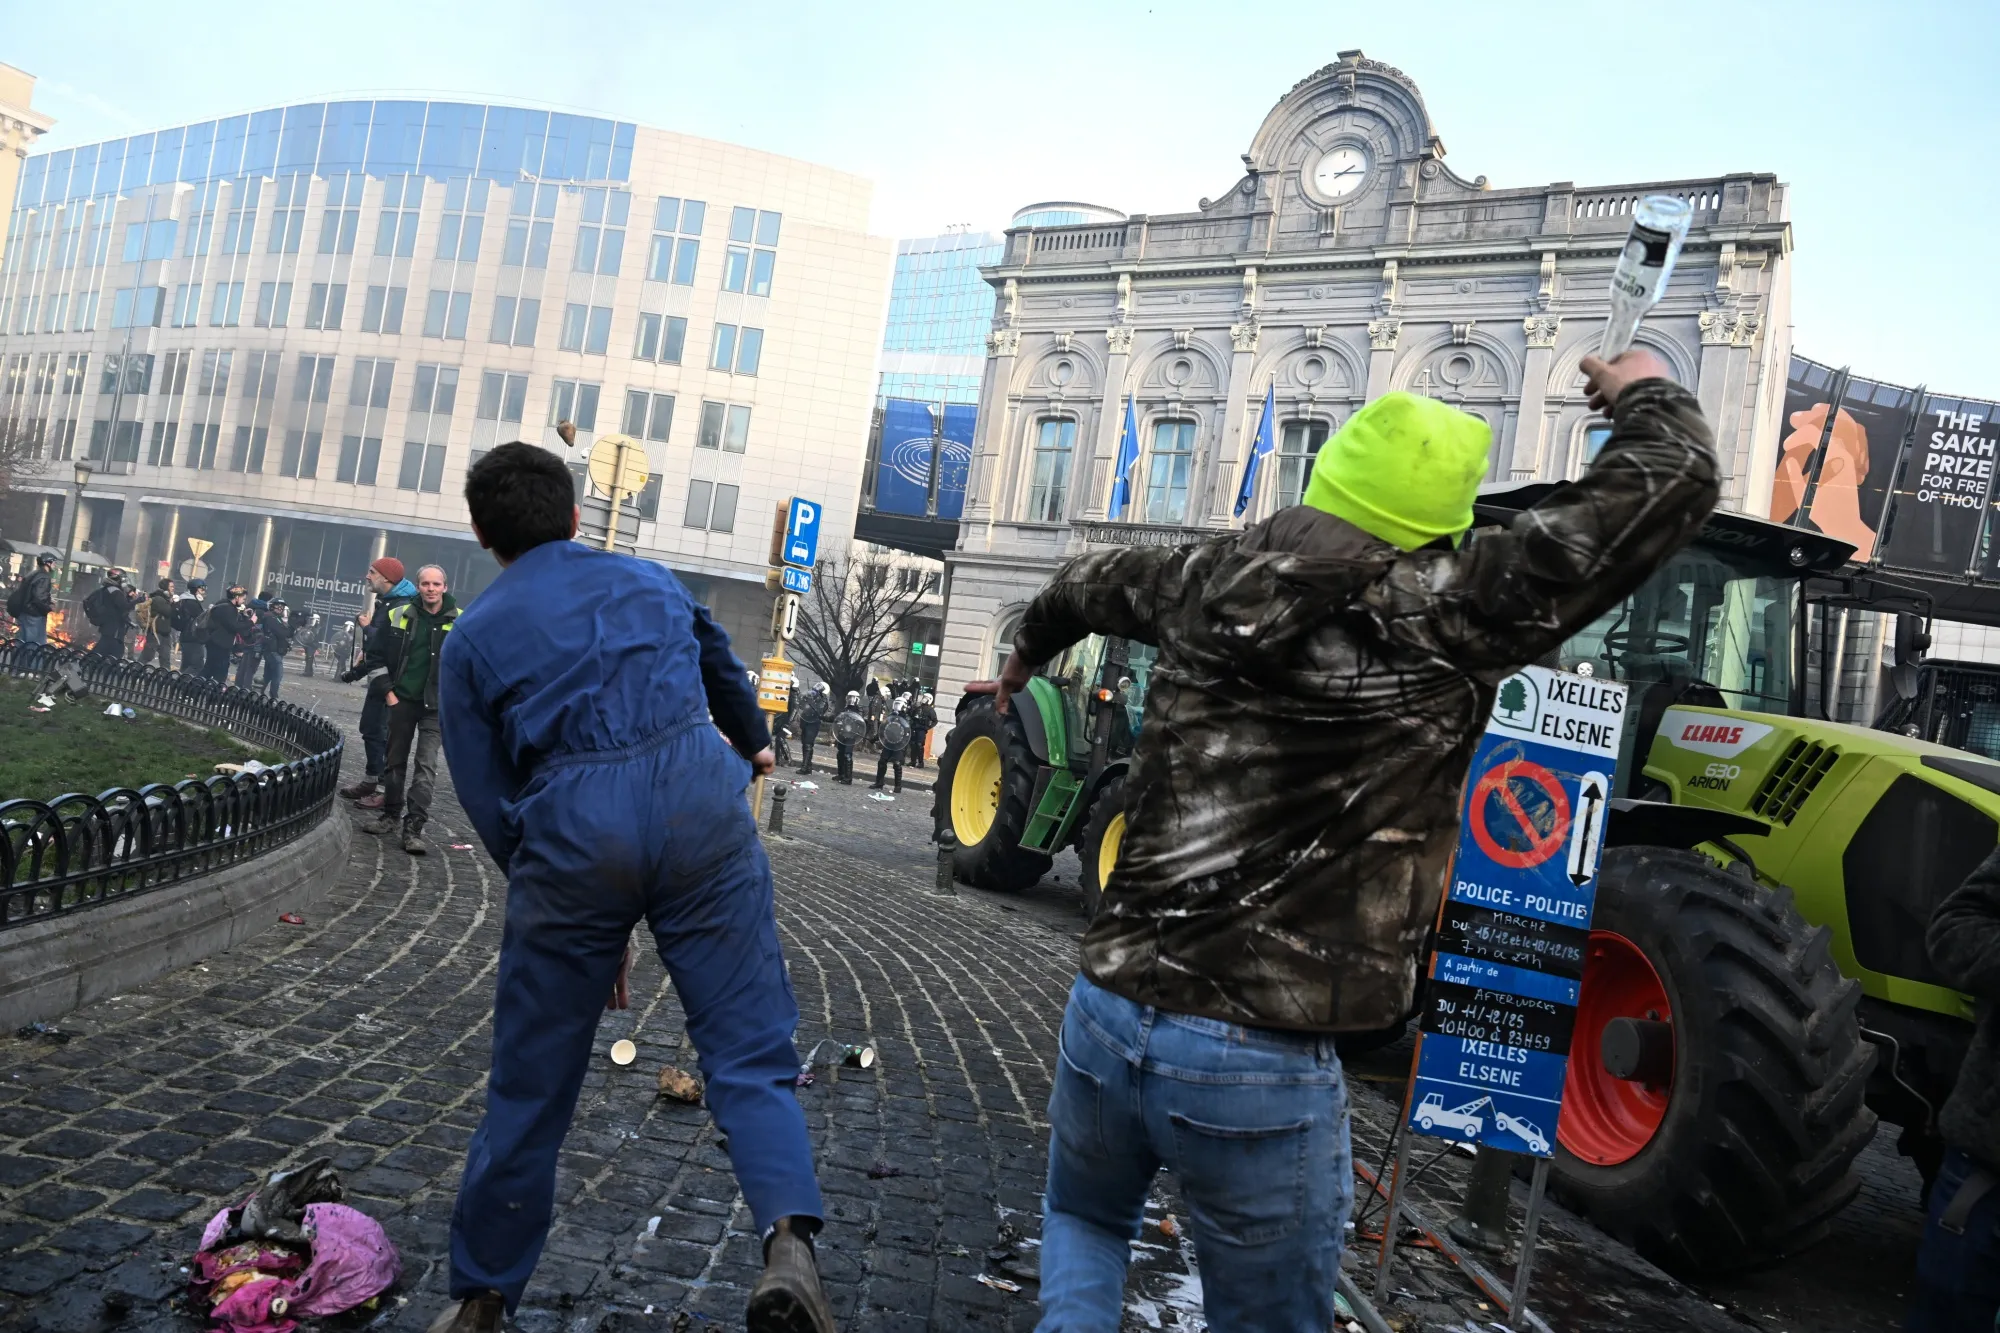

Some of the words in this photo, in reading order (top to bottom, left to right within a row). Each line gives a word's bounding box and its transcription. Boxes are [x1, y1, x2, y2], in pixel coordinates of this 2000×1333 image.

[1936, 410, 1983, 433] THE
[1929, 431, 1996, 457] SAKH
[1924, 453, 1993, 478] PRIZE
[1920, 473, 1953, 490] FOR
[1956, 479, 1988, 495] FRE
[1917, 489, 1940, 503] OF
[1943, 493, 1984, 510] THOU
[793, 502, 815, 537] P
[1701, 524, 1768, 547] RION
[1547, 678, 1623, 714] IXELLES
[1541, 713, 1614, 748] ELSENE
[1681, 724, 1744, 744] CLAAS
[1705, 763, 1741, 779] 630
[1687, 775, 1731, 791] ARION
[1456, 881, 1512, 906] POLICE
[1525, 894, 1587, 919] POLITIE
[1443, 972, 1470, 985] Vanaf
[1456, 961, 1485, 974] partir
[1487, 967, 1499, 977] de
[1436, 999, 1456, 1014] DU
[1461, 1038, 1528, 1064] IXELLES
[1459, 1061, 1523, 1087] ELSENE
